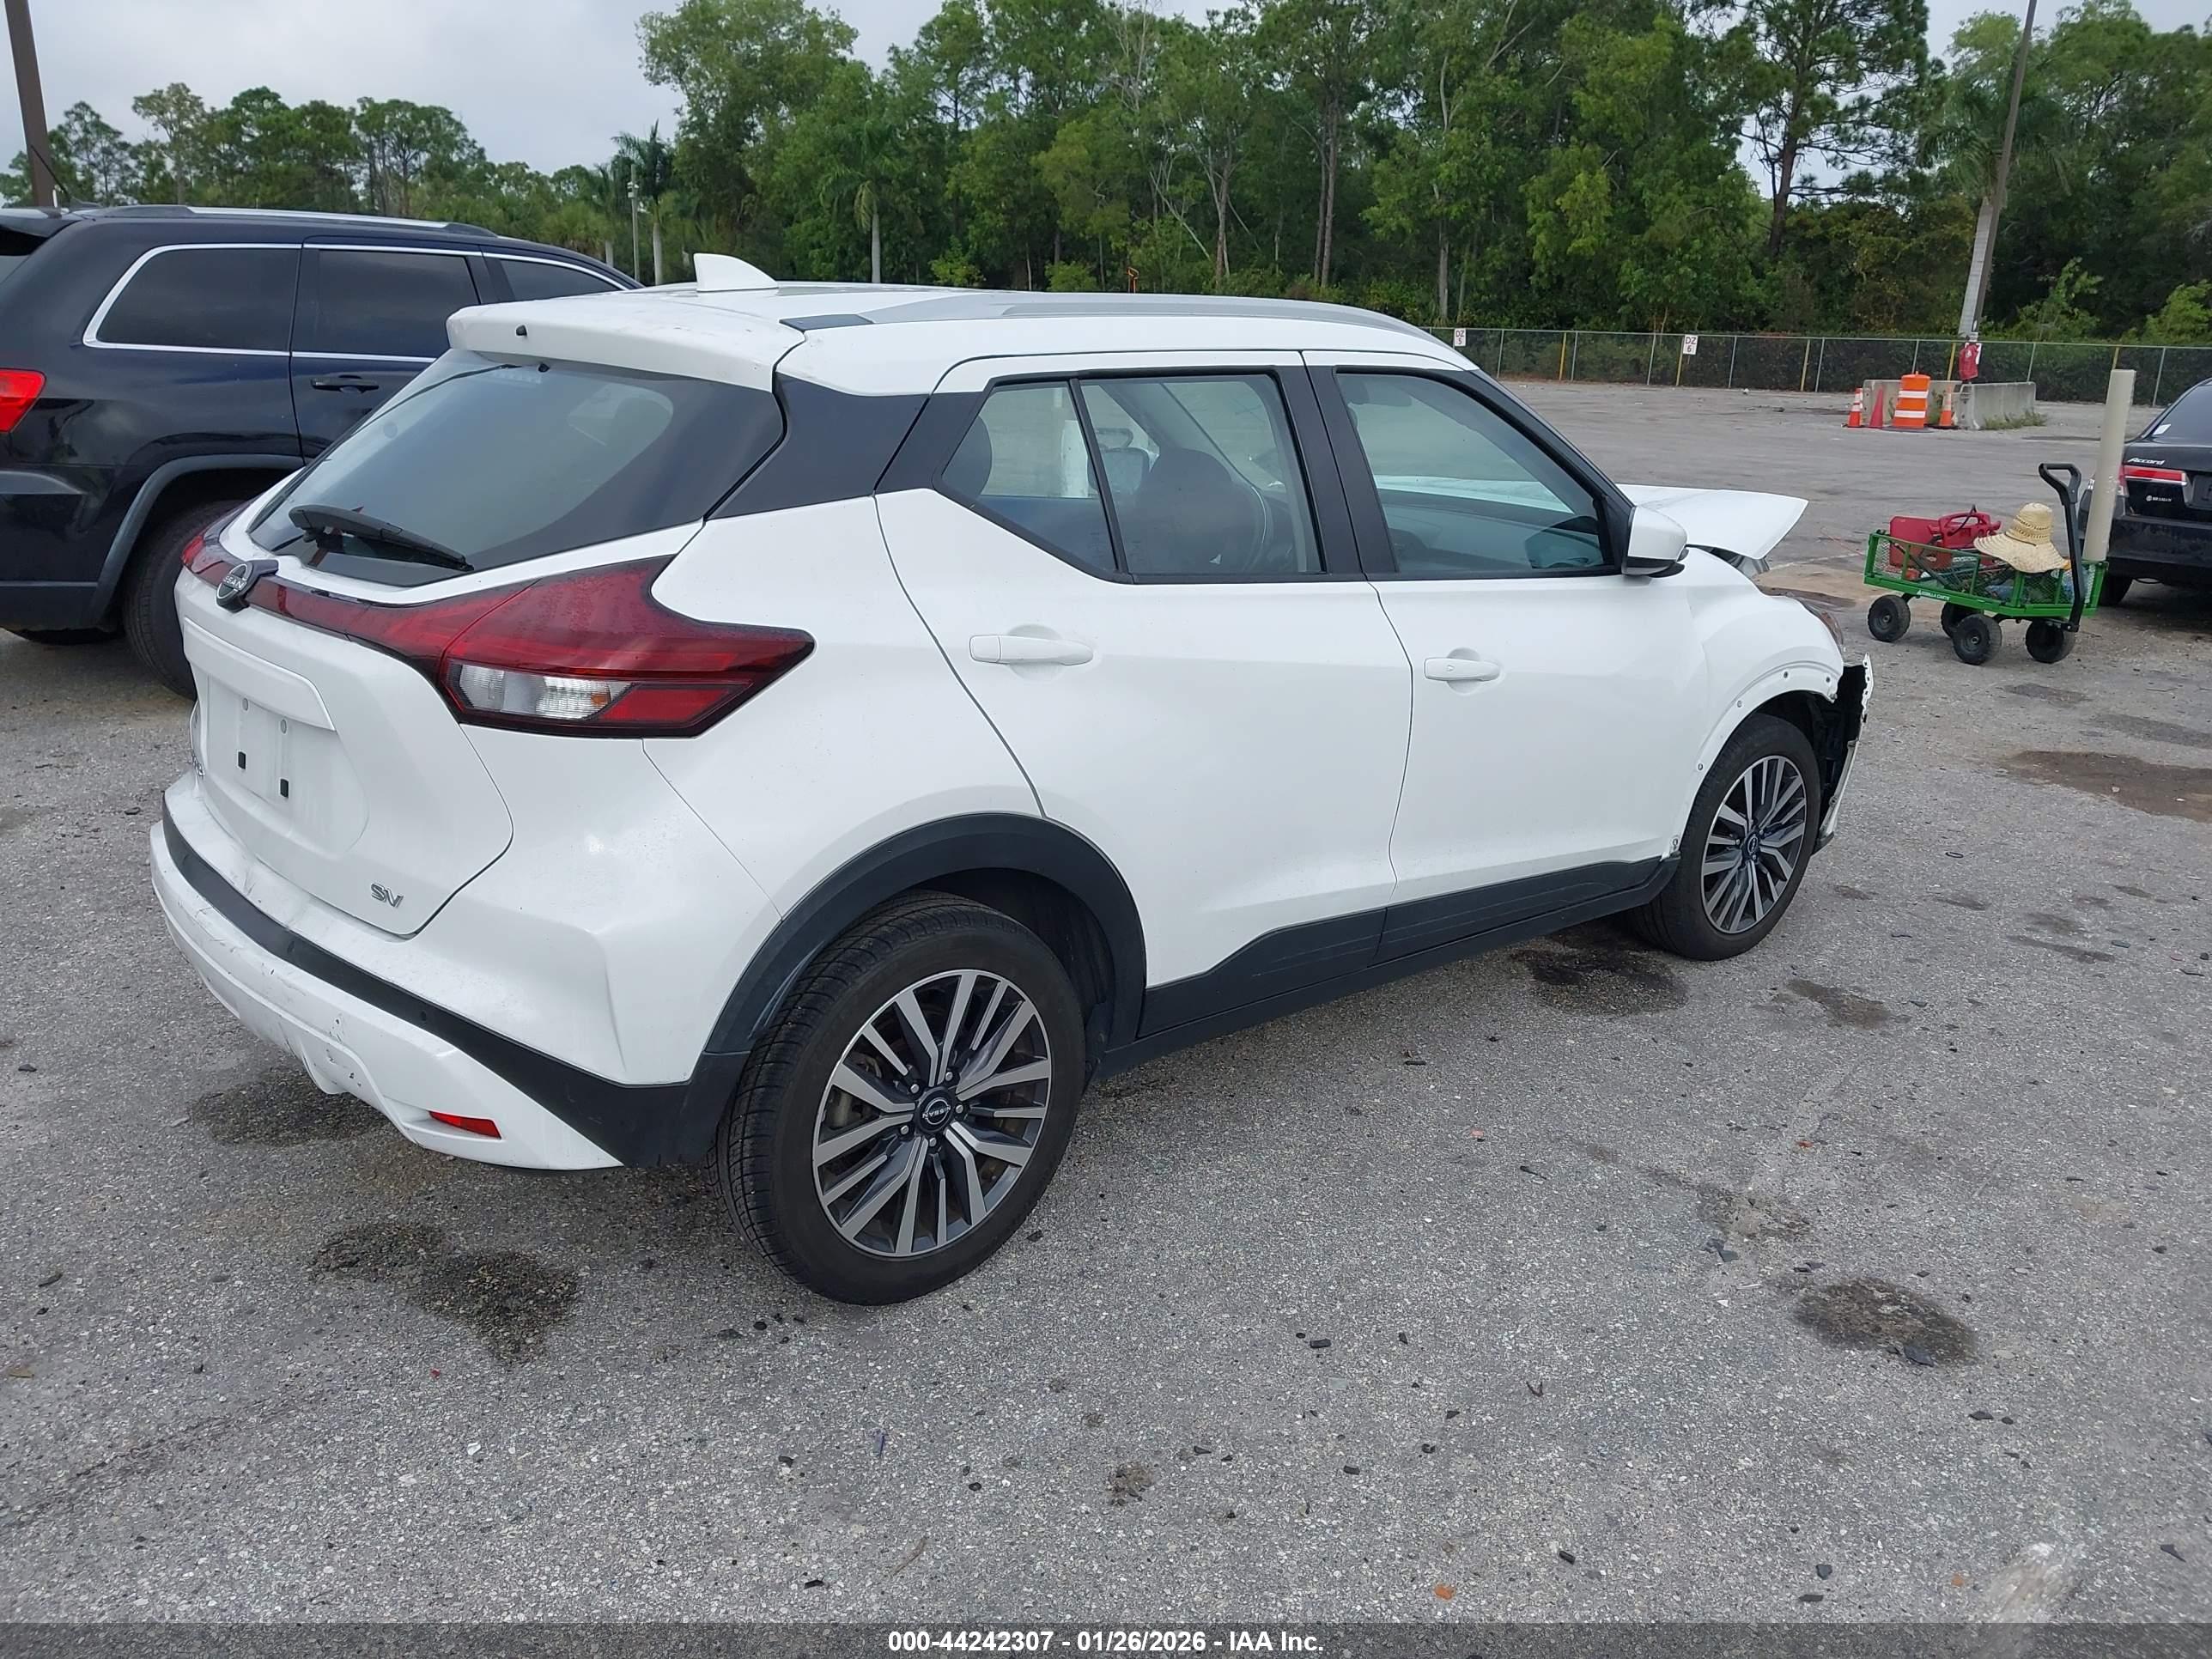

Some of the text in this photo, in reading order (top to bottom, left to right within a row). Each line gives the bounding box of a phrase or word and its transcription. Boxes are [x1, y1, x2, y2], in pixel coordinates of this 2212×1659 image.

[1685, 336, 1697, 344] DZ
[1686, 344, 1692, 353] 6
[371, 884, 404, 908] SV
[921, 1105, 951, 1119] NISSAN
